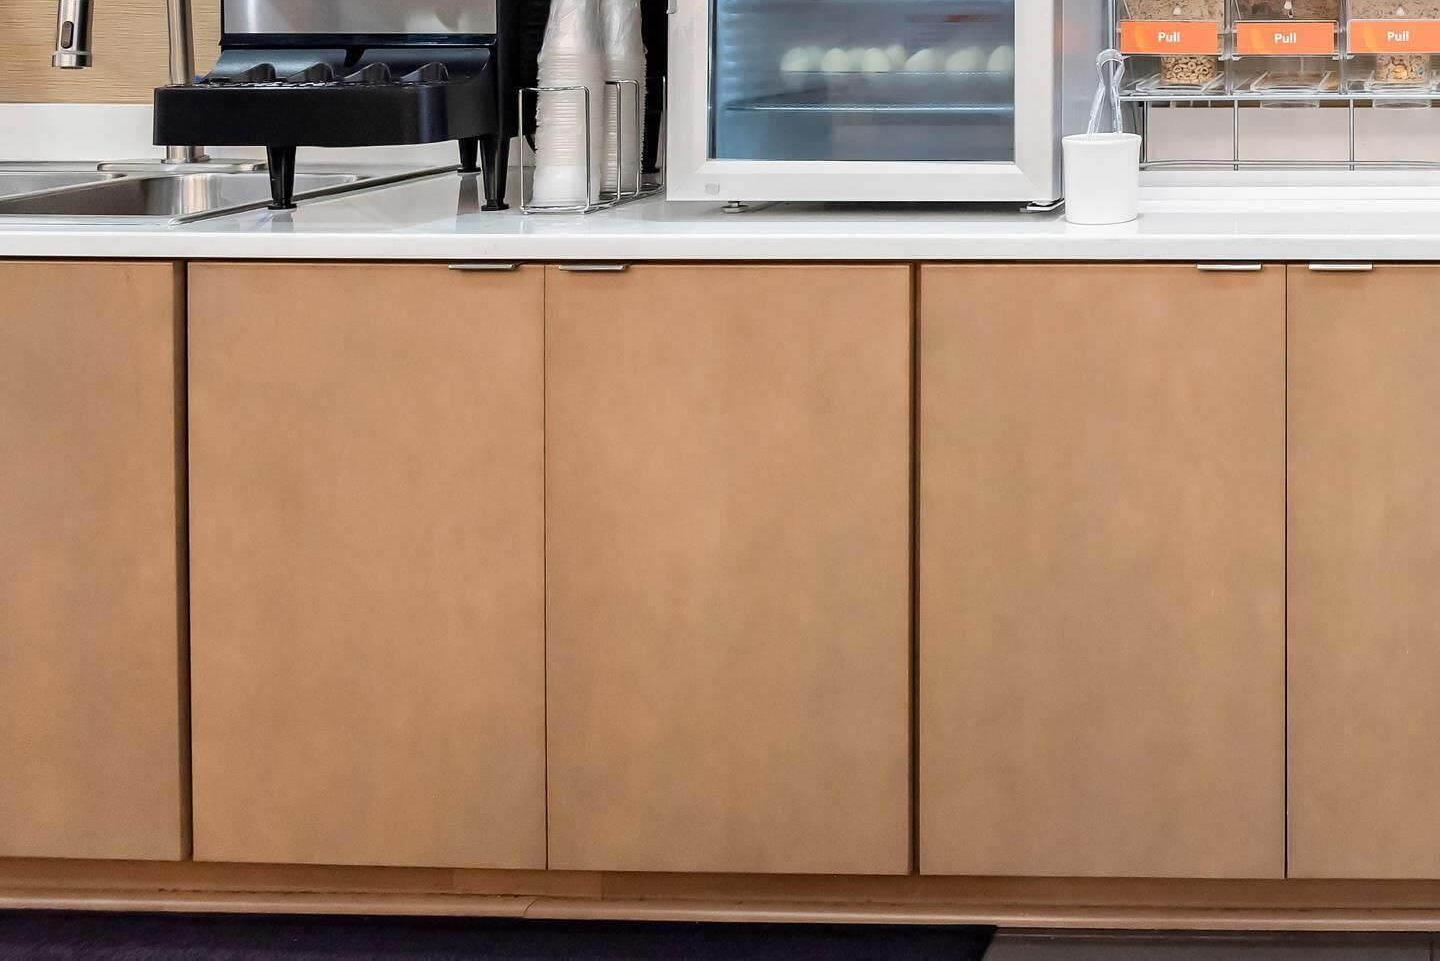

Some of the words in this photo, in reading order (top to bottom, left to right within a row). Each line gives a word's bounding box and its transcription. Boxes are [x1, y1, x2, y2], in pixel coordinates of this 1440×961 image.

[1158, 31, 1181, 43] Pull
[1274, 32, 1297, 44] Pull
[1386, 30, 1410, 42] Pull
